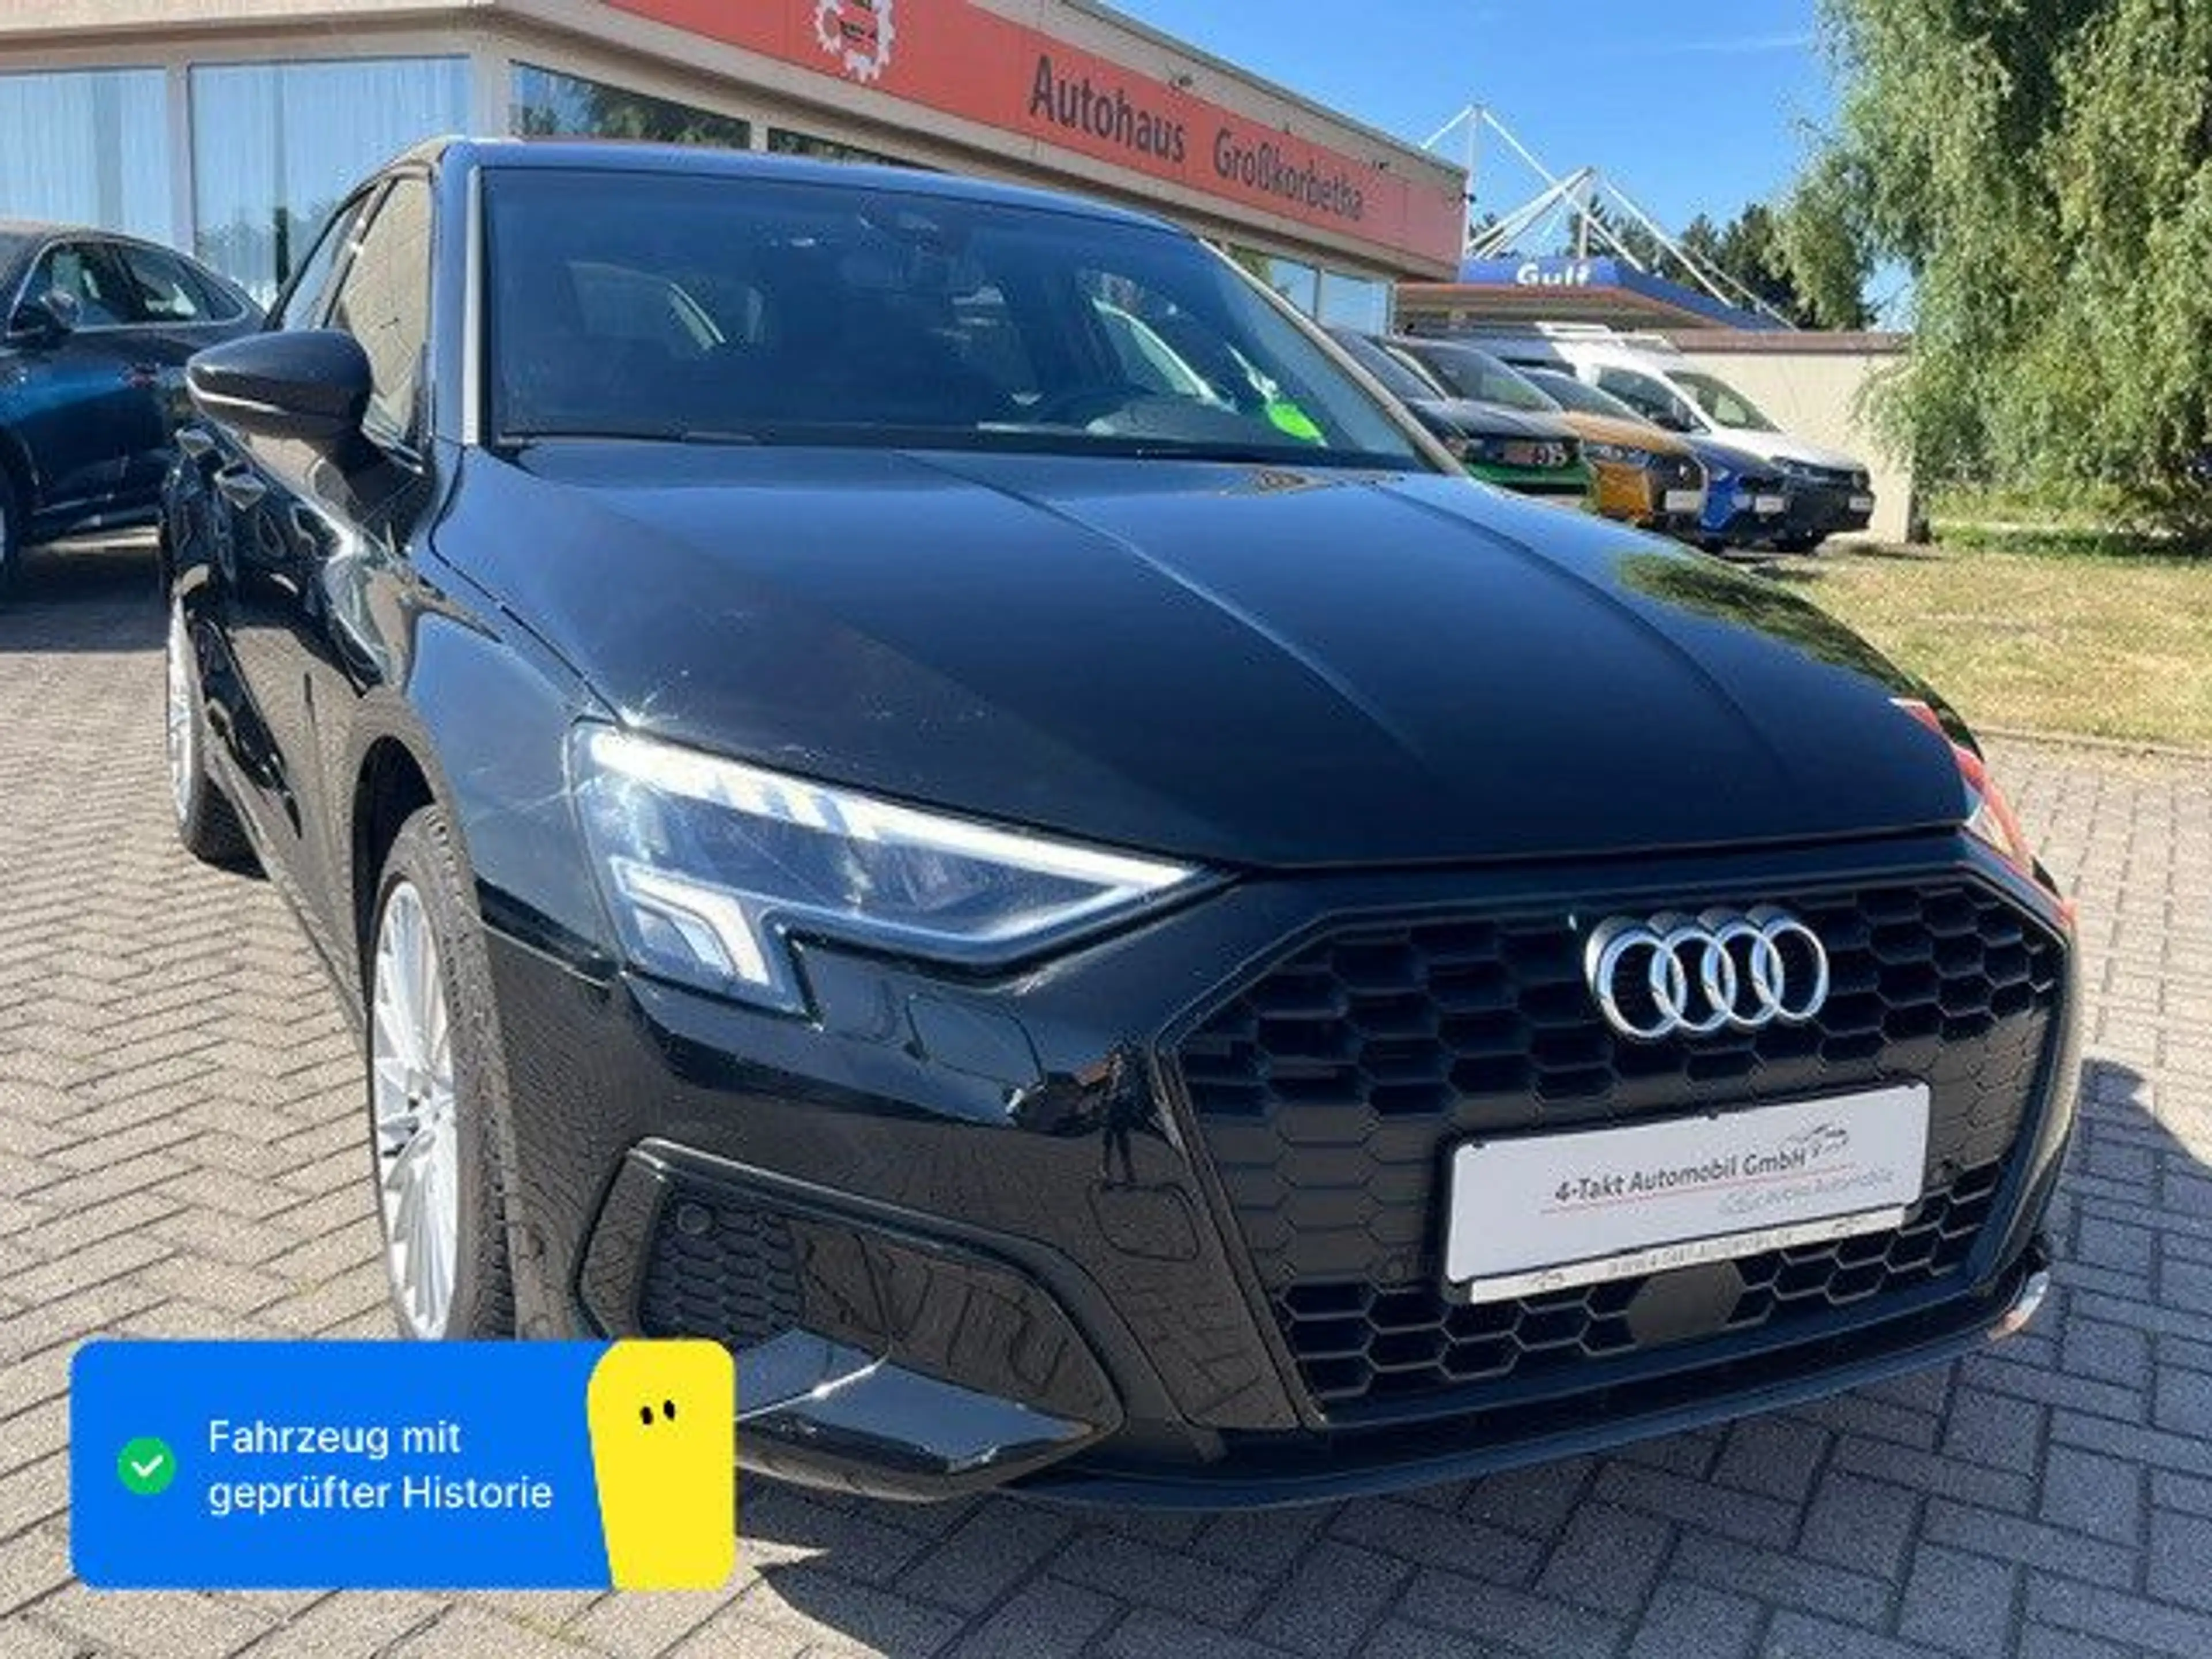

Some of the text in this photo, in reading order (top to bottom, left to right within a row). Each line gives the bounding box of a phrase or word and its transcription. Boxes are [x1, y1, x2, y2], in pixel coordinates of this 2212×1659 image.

[1030, 54, 1187, 164] Autohaus
[1516, 262, 1591, 287] Gulf
[1555, 1173, 1625, 1202] 4-Takt
[1630, 1154, 1737, 1192] Automobil
[1743, 1148, 1806, 1176] GmbH
